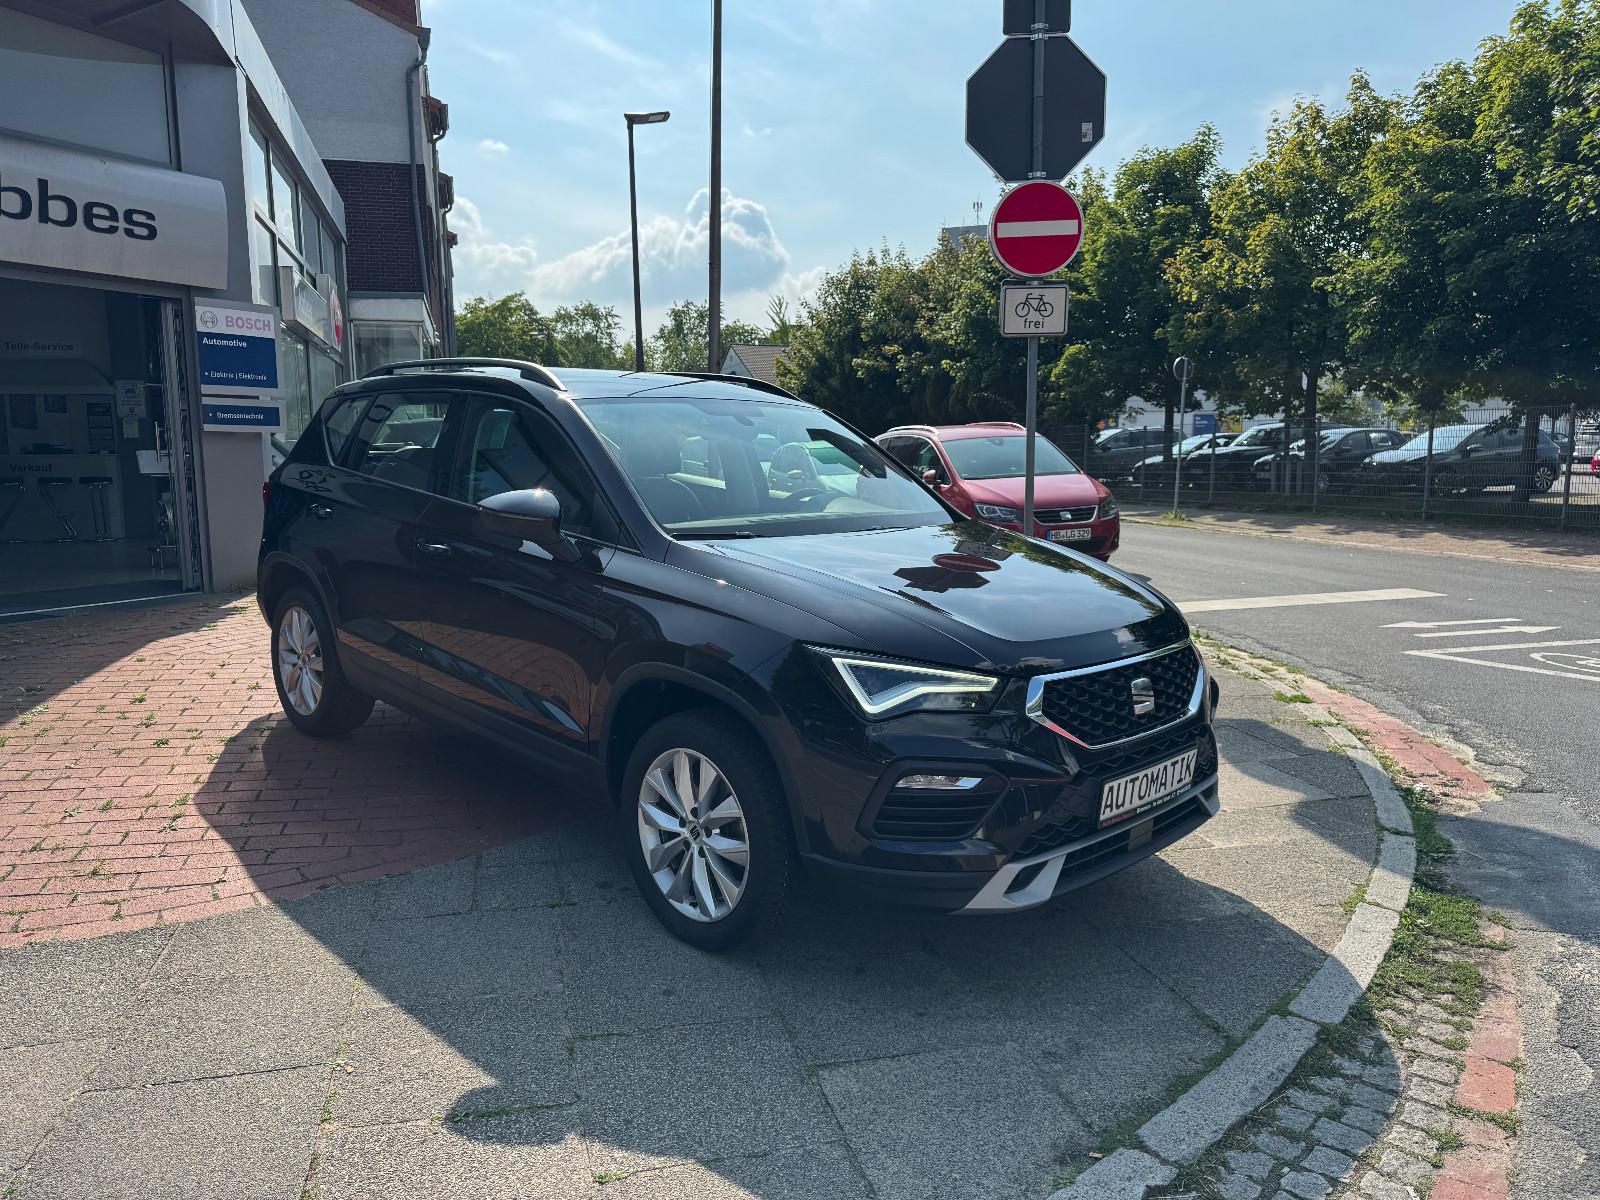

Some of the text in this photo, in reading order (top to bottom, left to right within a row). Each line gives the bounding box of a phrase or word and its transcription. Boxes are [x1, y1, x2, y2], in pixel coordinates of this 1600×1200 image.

[225, 315, 271, 332] BOSCH
[1023, 317, 1045, 329] frei
[202, 336, 248, 348] Automotive
[1077, 529, 1090, 538] 329
[1102, 751, 1196, 816] AUTOMATIK
